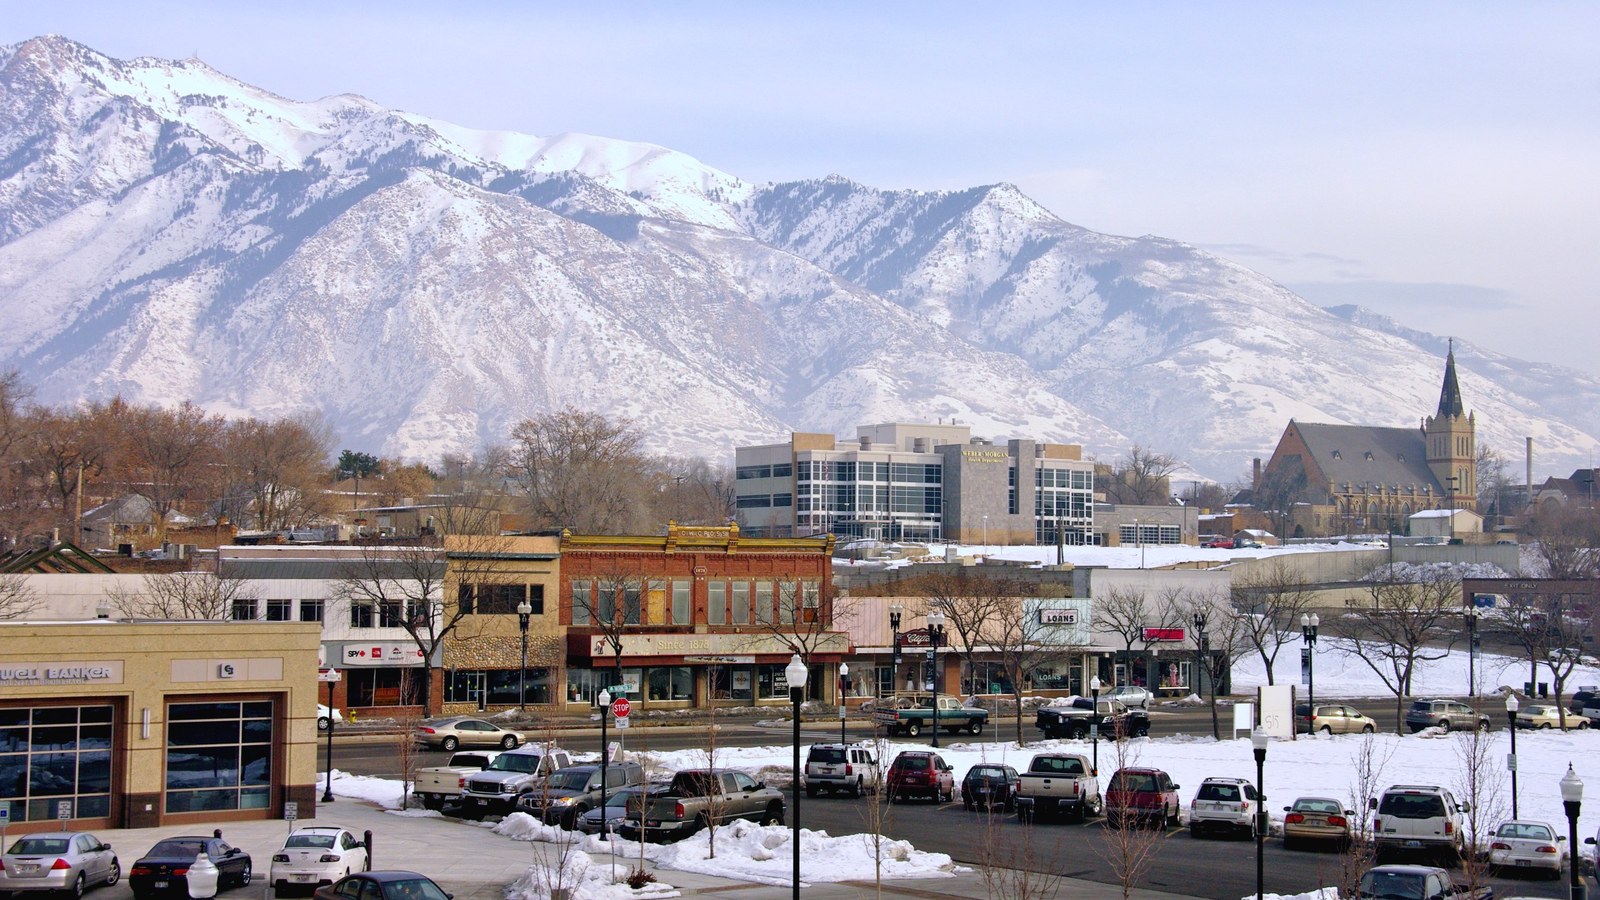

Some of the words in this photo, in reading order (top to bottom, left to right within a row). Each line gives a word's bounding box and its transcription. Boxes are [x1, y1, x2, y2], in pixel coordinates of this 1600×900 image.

[1047, 615, 1074, 623] LOANS
[658, 640, 685, 651] Since
[689, 639, 711, 650] 1878
[348, 650, 360, 658] SPY
[614, 703, 630, 713] STOP
